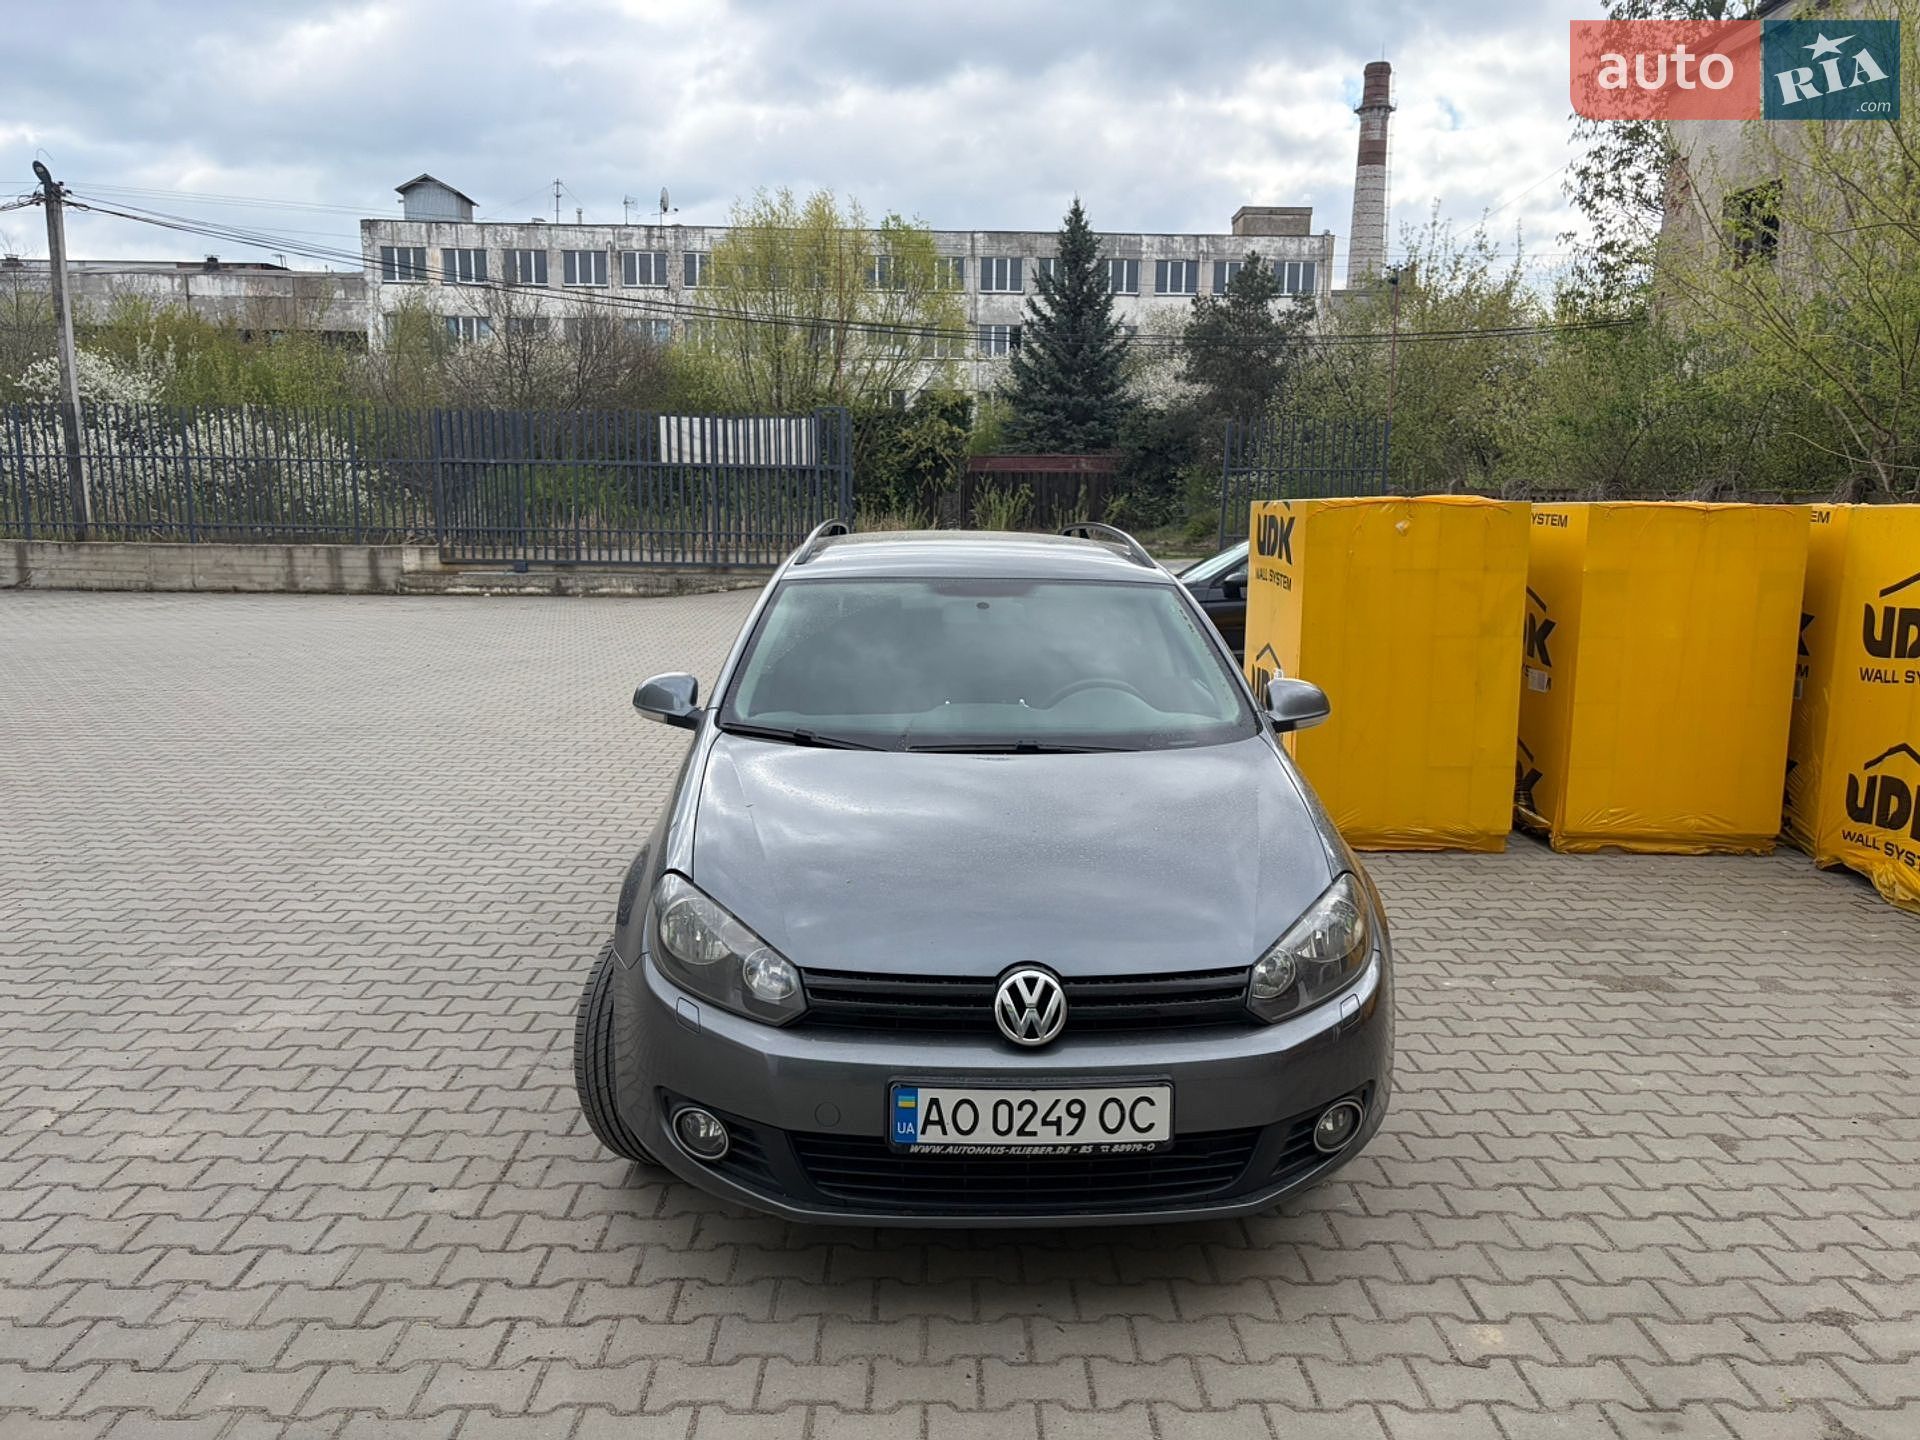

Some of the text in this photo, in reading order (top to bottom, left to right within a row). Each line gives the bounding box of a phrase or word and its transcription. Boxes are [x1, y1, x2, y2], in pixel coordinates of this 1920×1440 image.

[1531, 512, 1568, 528] YSTEM
[1257, 513, 1295, 565] UDK
[1256, 567, 1292, 592] WALL SYSTEM
[1863, 603, 1920, 659] UD
[1251, 664, 1273, 711] UD
[1859, 667, 1899, 684] WALL
[1845, 773, 1920, 843] UD
[1842, 829, 1880, 850] WALL
[897, 1122, 915, 1135] UA
[920, 1096, 1155, 1137] AO 0249 OC
